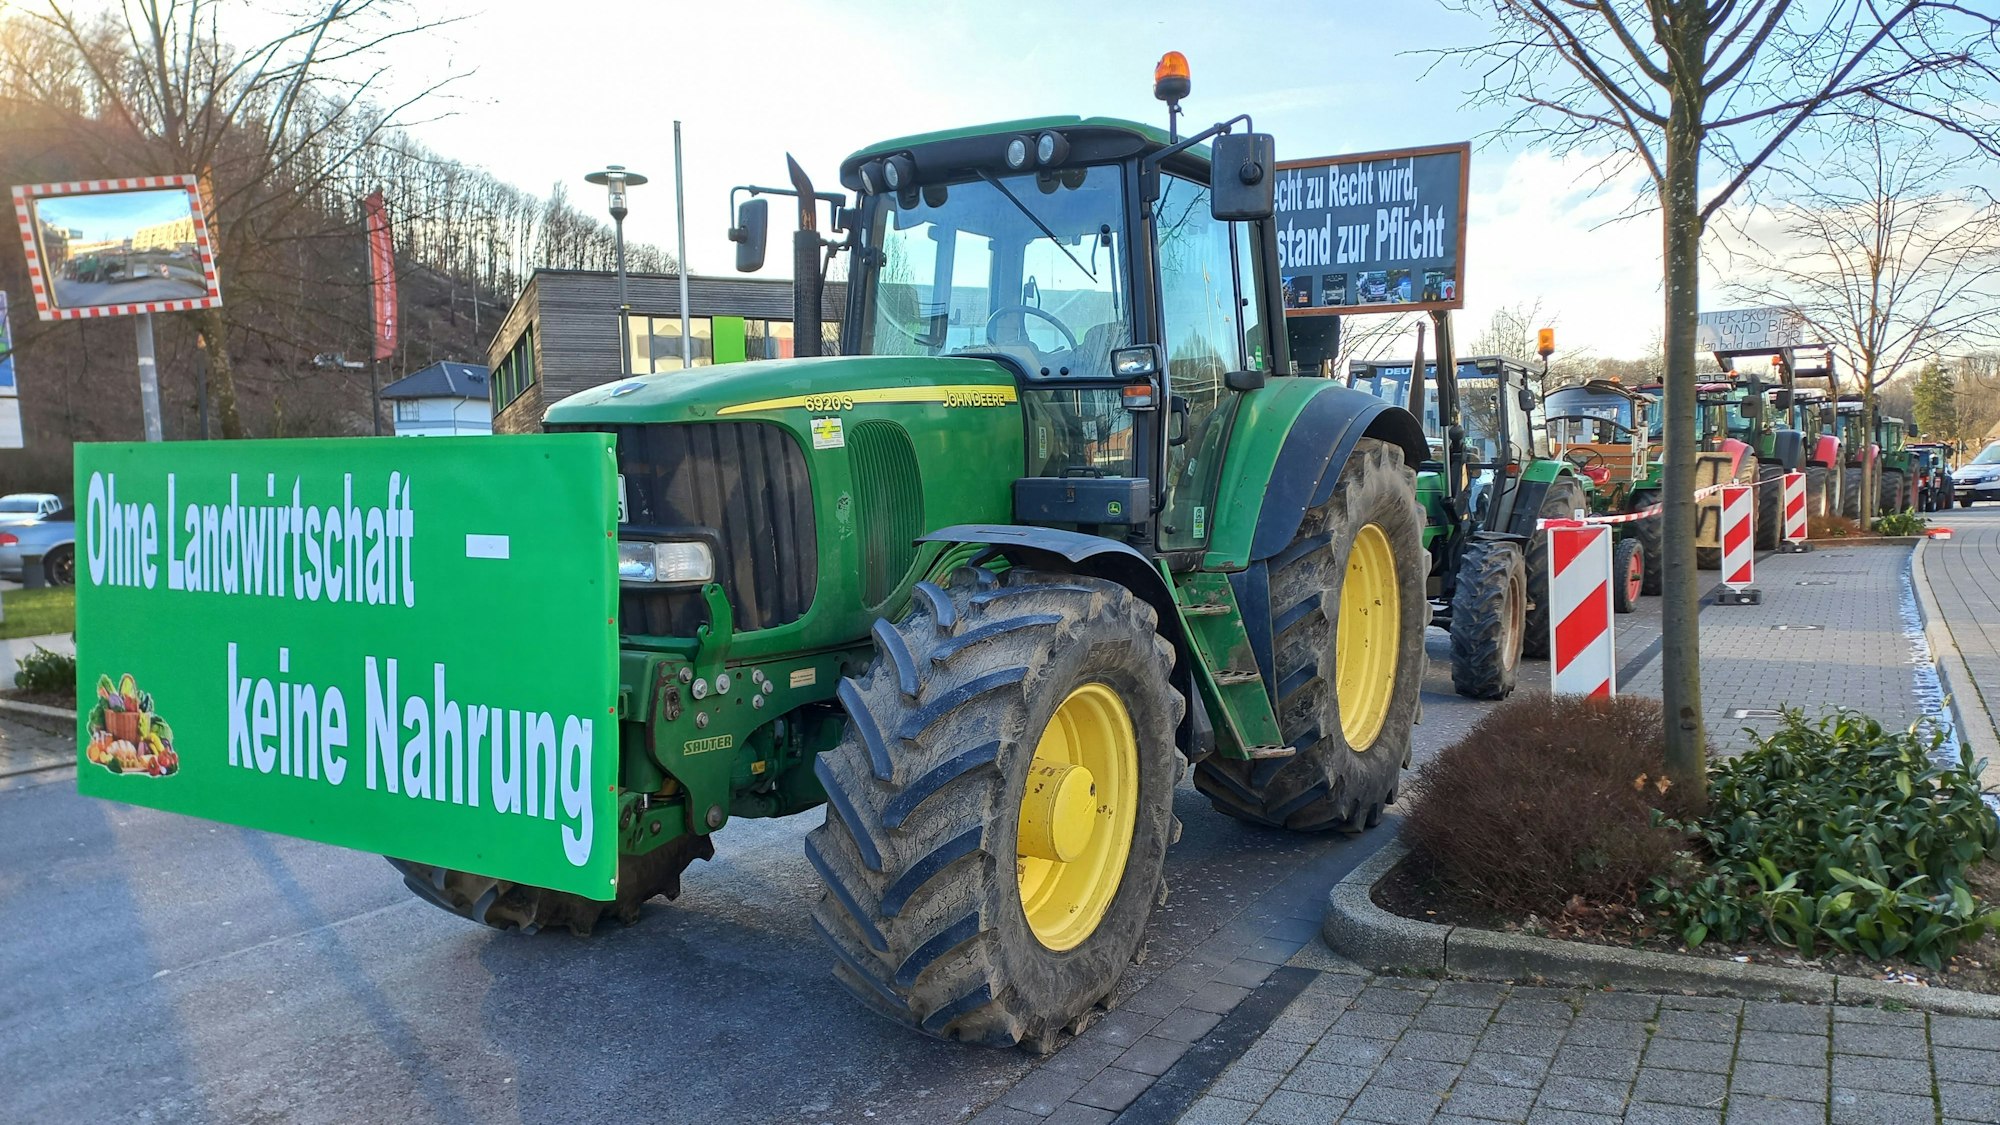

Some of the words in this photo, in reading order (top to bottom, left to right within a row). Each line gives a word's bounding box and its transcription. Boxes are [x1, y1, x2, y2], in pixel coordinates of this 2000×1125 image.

[1306, 176, 1324, 209] zu
[1328, 161, 1374, 208] Recht
[1378, 157, 1418, 211] wird,
[1336, 223, 1370, 264] zur
[1375, 204, 1446, 261] Pflicht
[1719, 334, 1744, 350] bald
[1746, 332, 1771, 348] auch
[1776, 330, 1801, 346] DIR
[1722, 322, 1761, 335] UND
[1768, 317, 1800, 332] BIER
[943, 390, 974, 408] JOHN
[973, 390, 1006, 407] DEERE
[86, 470, 158, 588] Ohne
[166, 470, 416, 608] Landwirtschaft
[226, 641, 348, 786] keine
[365, 655, 594, 867] Nahrung
[684, 735, 732, 755] SAUTER
